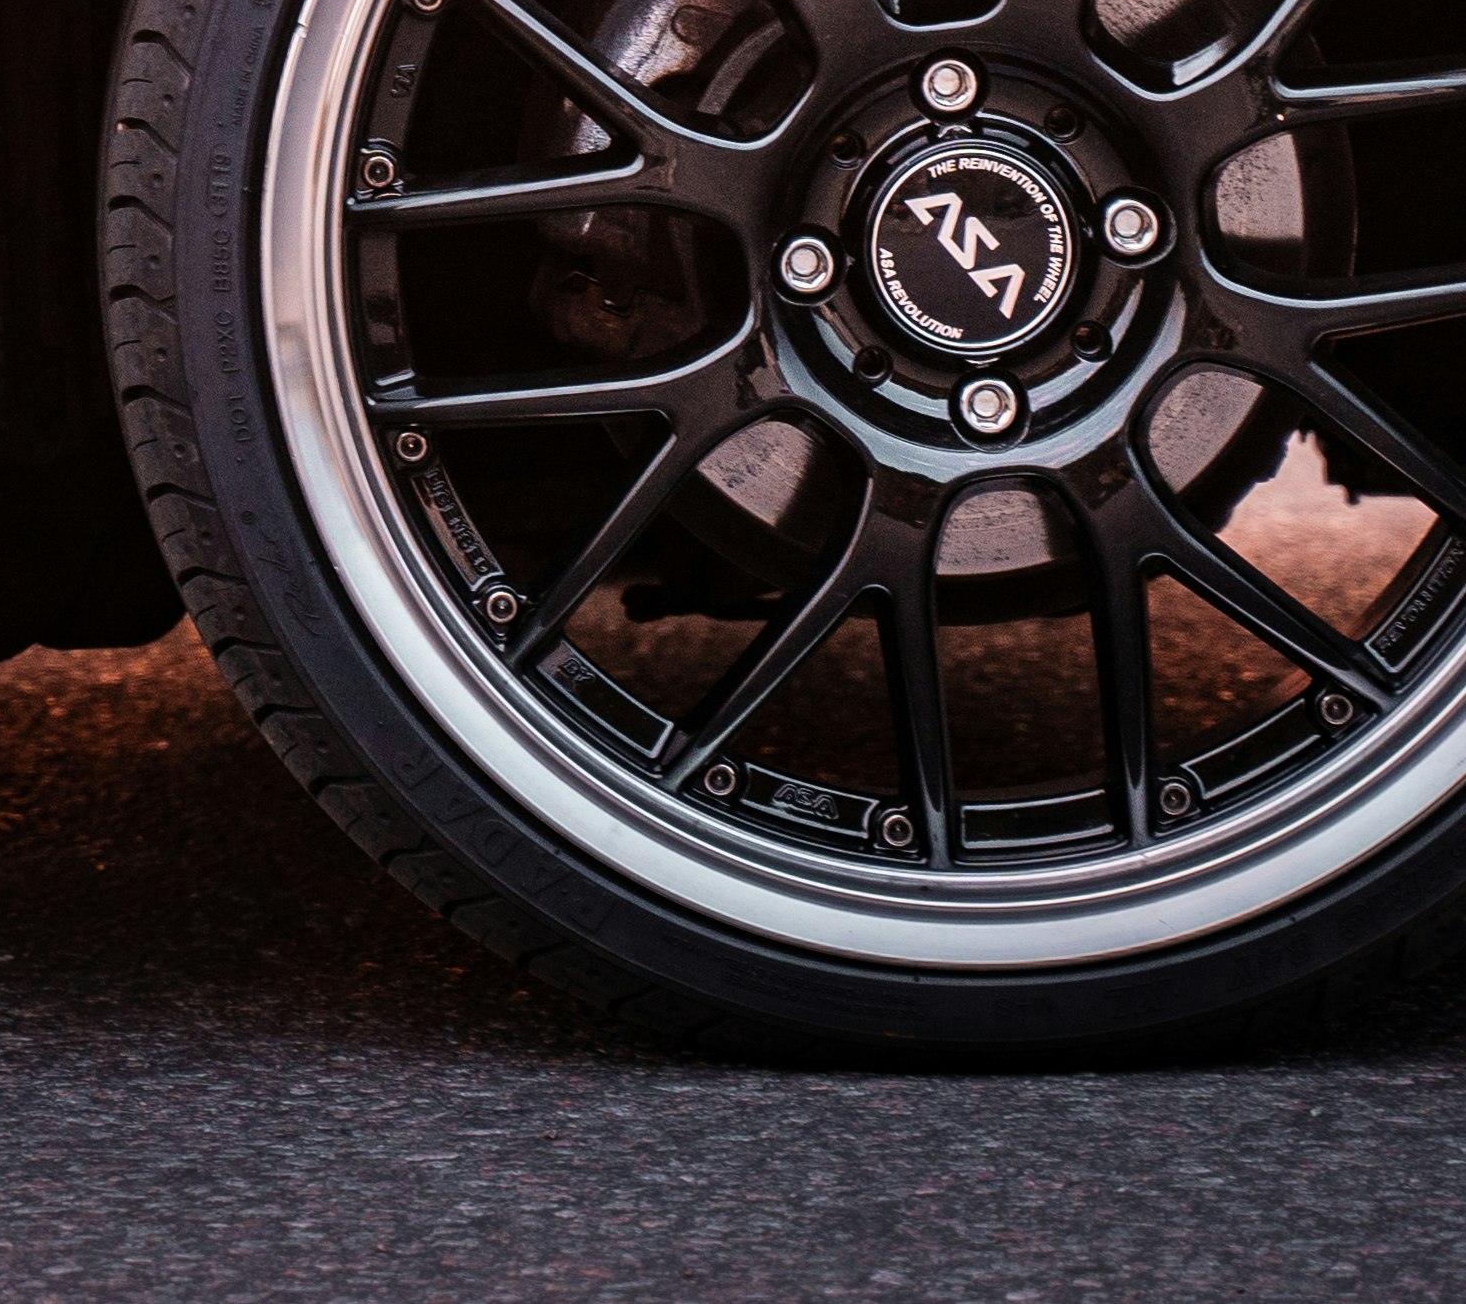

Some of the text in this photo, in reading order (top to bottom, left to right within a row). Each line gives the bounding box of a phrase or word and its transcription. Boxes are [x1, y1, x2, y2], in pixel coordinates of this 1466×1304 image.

[230, 24, 265, 126] MADE IN CHINA
[879, 248, 964, 339] ASA REVOLUTION
[904, 192, 1026, 320] ASA
[927, 157, 1064, 303] THE REINVENTION OF THE WHEEL
[226, 391, 254, 444] DOT
[421, 464, 841, 822] LICENSED BY ASA
[384, 735, 620, 938] RADAR
